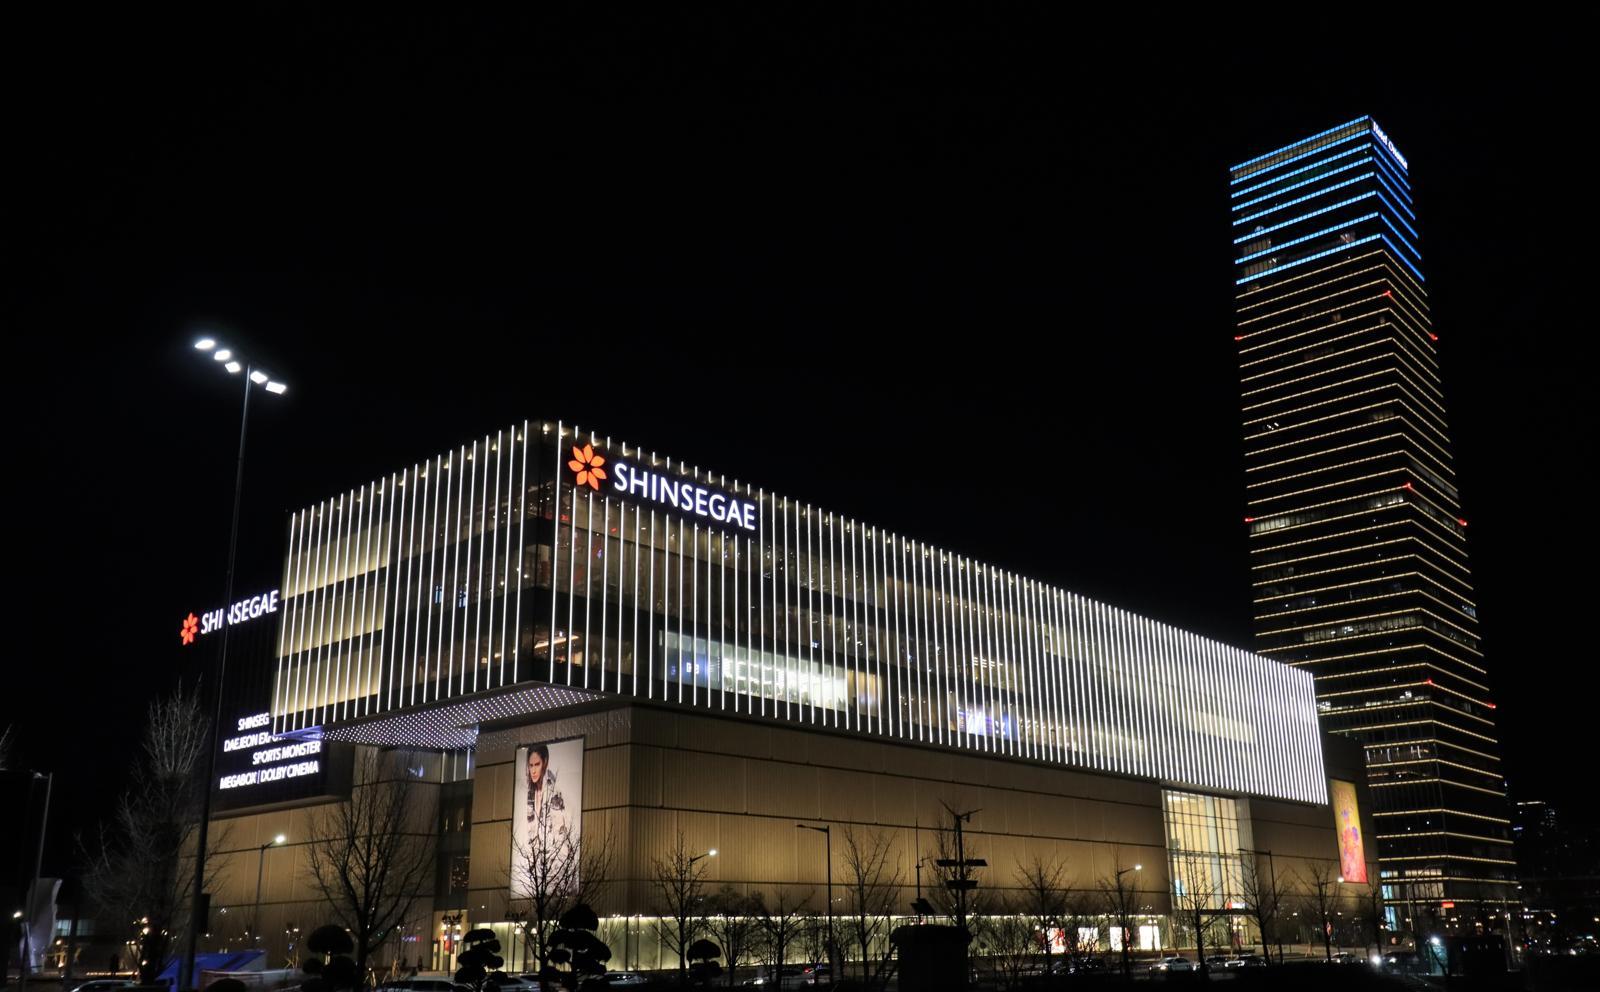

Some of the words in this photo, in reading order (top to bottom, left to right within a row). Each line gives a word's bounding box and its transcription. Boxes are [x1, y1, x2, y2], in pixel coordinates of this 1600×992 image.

[614, 463, 756, 531] SHINSEGAE
[223, 734, 259, 752] DAEJEON
[252, 748, 282, 765] SPORTS
[281, 741, 321, 759] MONSTER
[219, 772, 257, 789] MEGABOX
[260, 766, 288, 782] DOLBY
[286, 760, 319, 778] CINEMA
